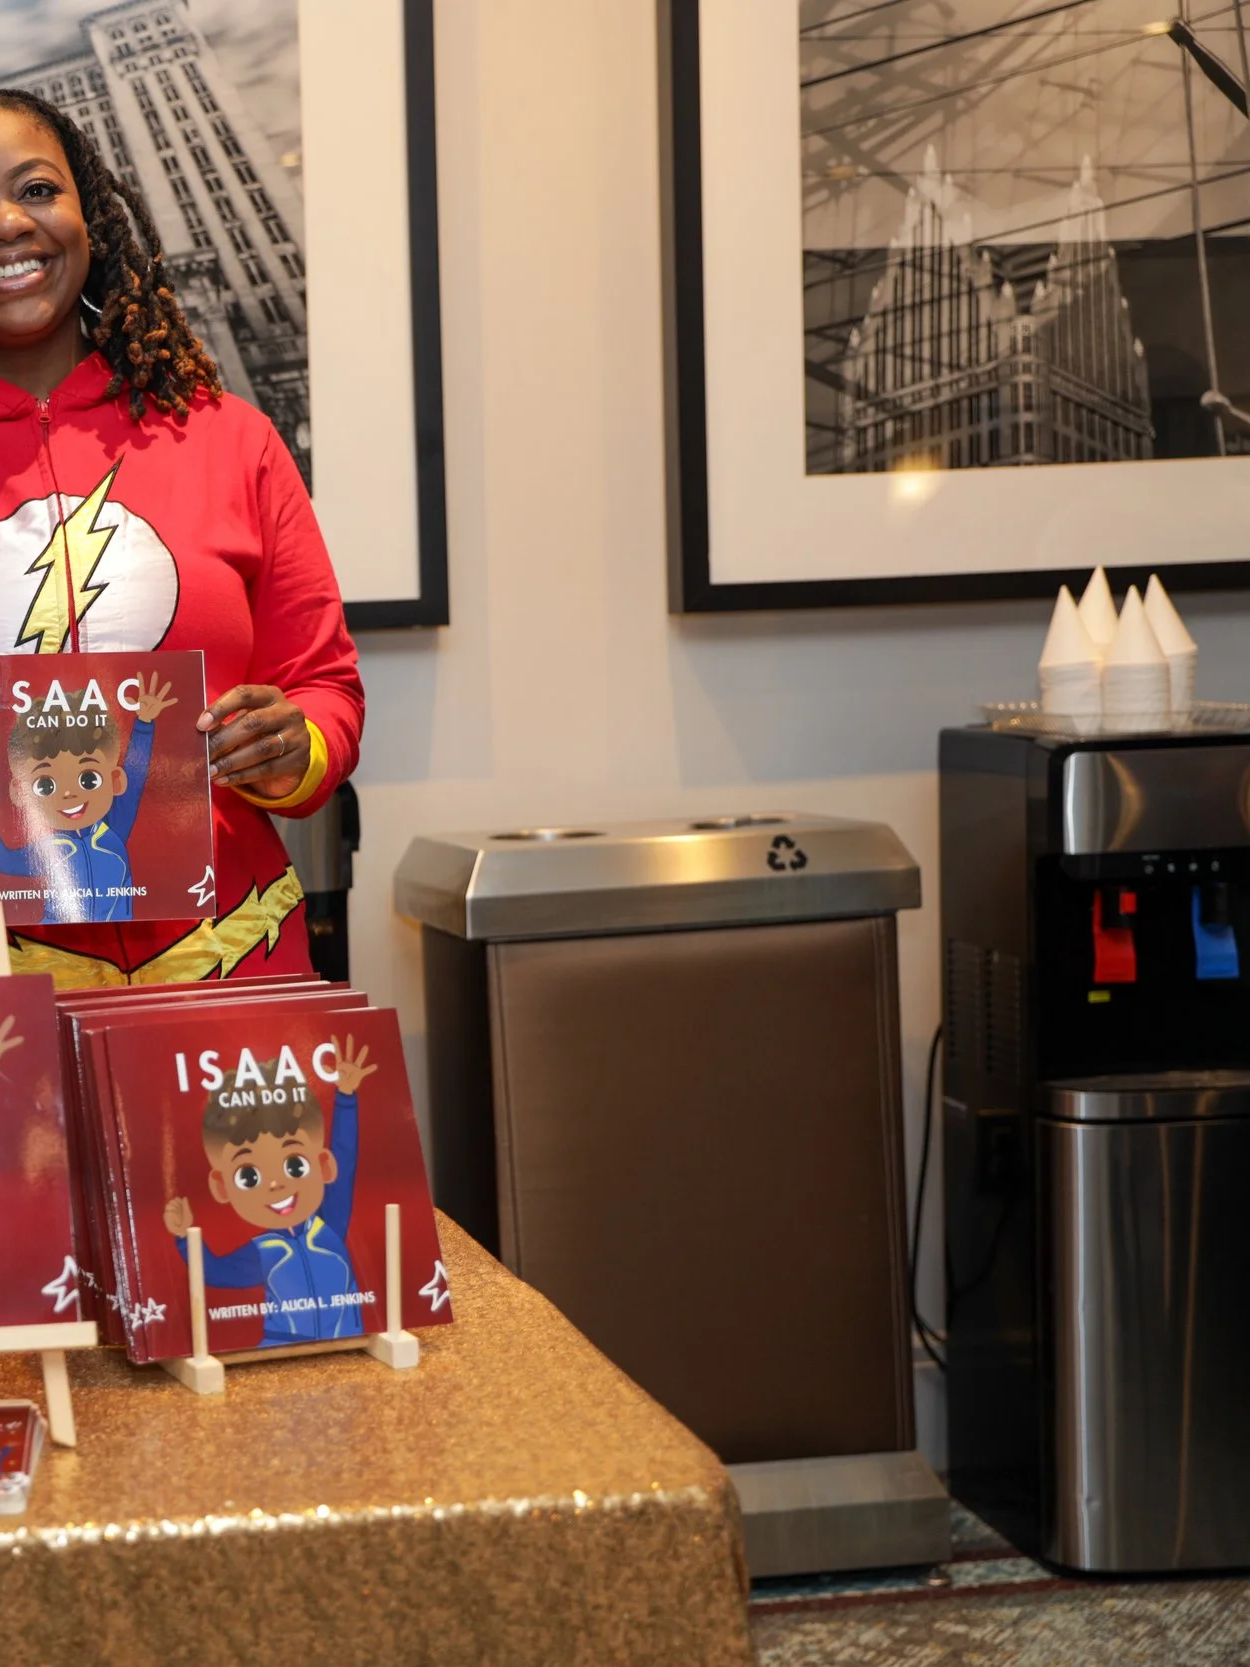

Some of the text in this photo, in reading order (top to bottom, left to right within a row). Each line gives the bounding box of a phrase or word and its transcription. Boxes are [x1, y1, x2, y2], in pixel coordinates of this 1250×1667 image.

[26, 714, 108, 728] CAN DO IT
[96, 887, 103, 897] L.
[106, 886, 147, 897] JENKINS
[175, 1042, 340, 1092] ISAAC
[218, 1087, 307, 1108] CAN DO IT
[208, 1290, 376, 1321] WRITTEN BY: ALICIA L. JENKINS
